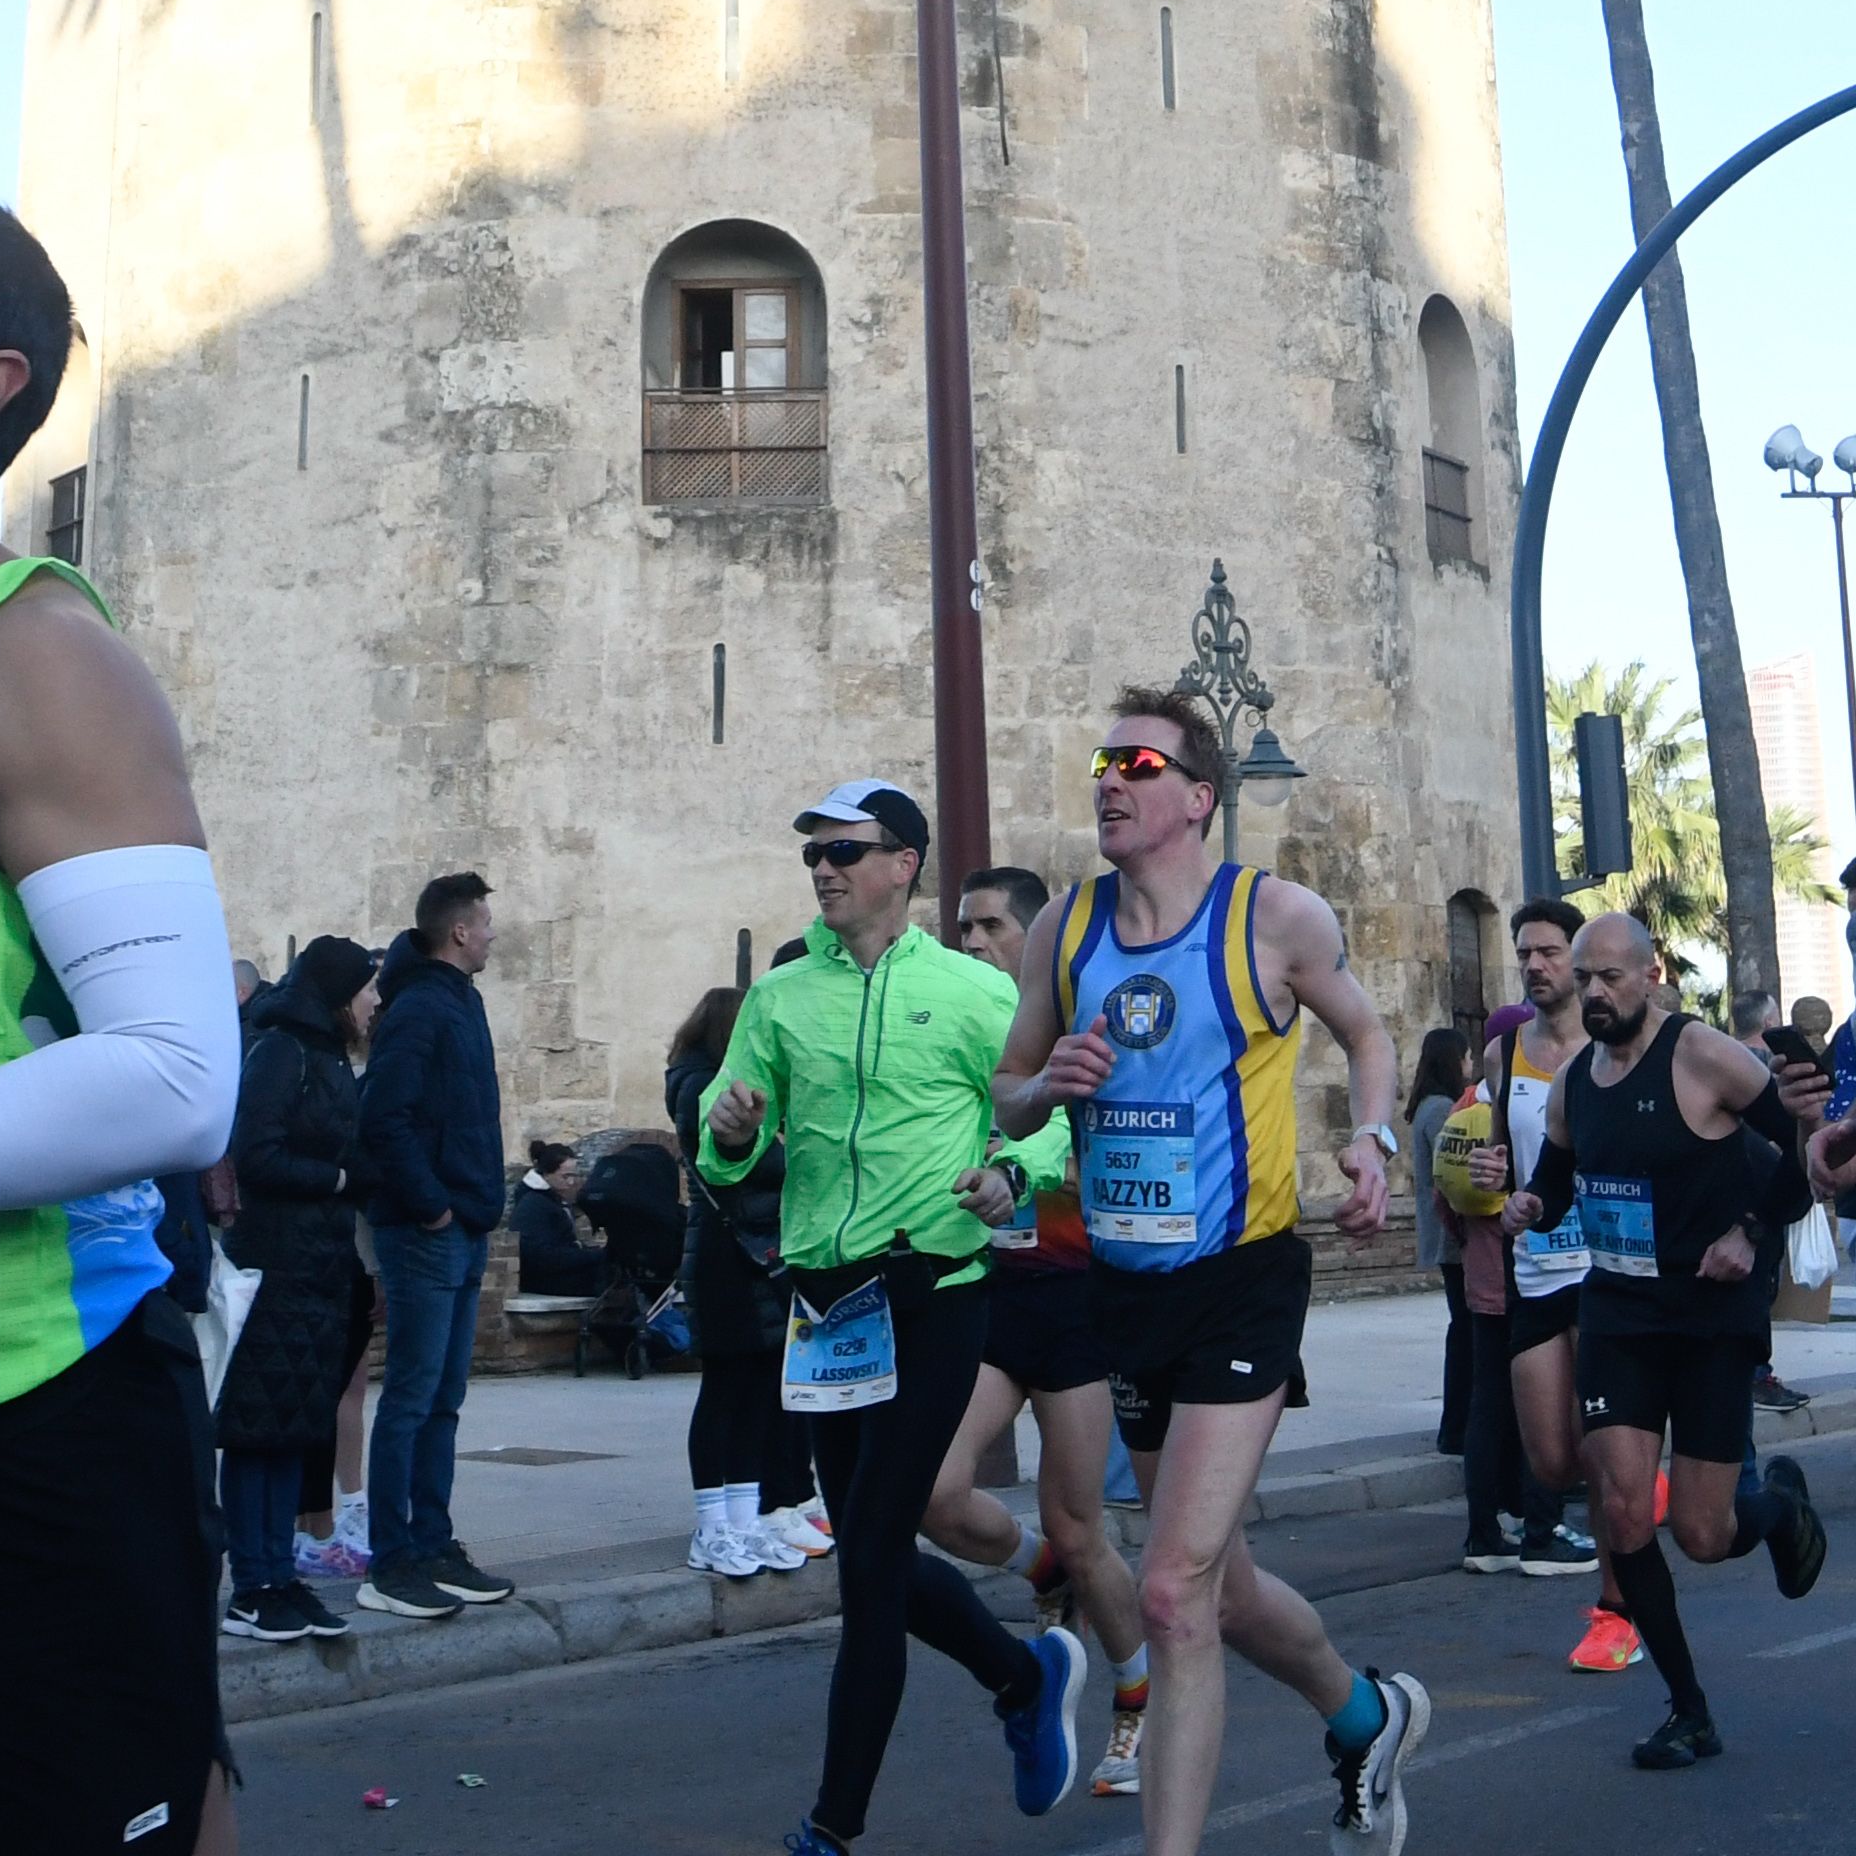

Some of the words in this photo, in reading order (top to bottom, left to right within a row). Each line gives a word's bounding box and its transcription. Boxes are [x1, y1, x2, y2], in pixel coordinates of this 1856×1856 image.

[1102, 1110, 1176, 1129] ZURICH
[1104, 1151, 1142, 1170] 5637
[1591, 1181, 1642, 1197] ZURICH
